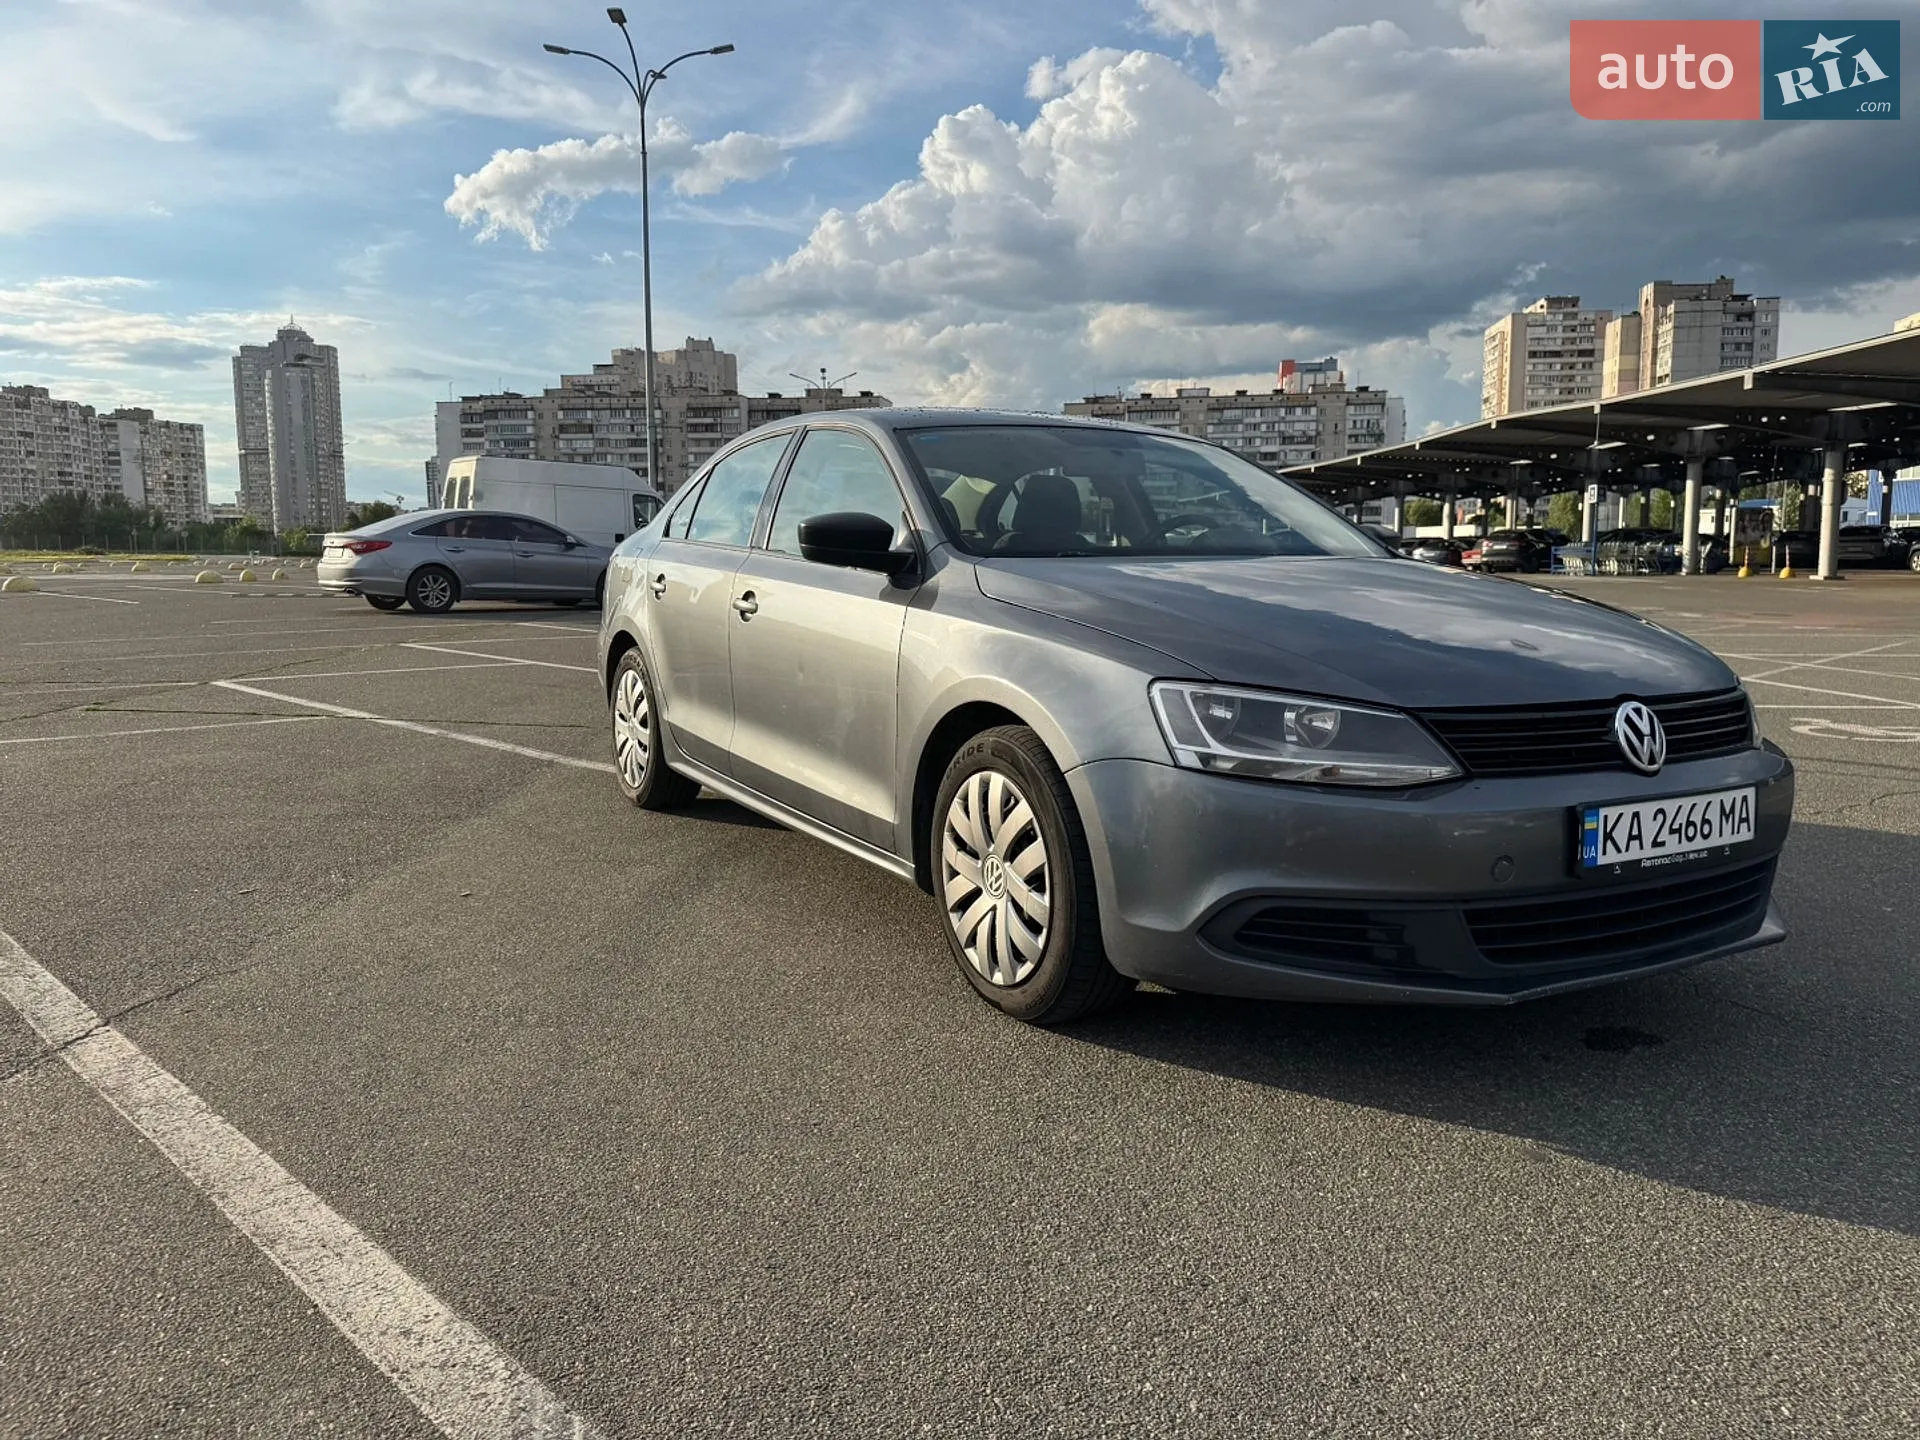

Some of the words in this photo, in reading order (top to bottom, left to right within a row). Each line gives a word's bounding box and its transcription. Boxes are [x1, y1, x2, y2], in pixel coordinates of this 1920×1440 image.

[1602, 811, 1644, 856] KA
[1650, 800, 1713, 849] 2466
[1719, 795, 1752, 838] MA
[1583, 846, 1596, 859] UA
